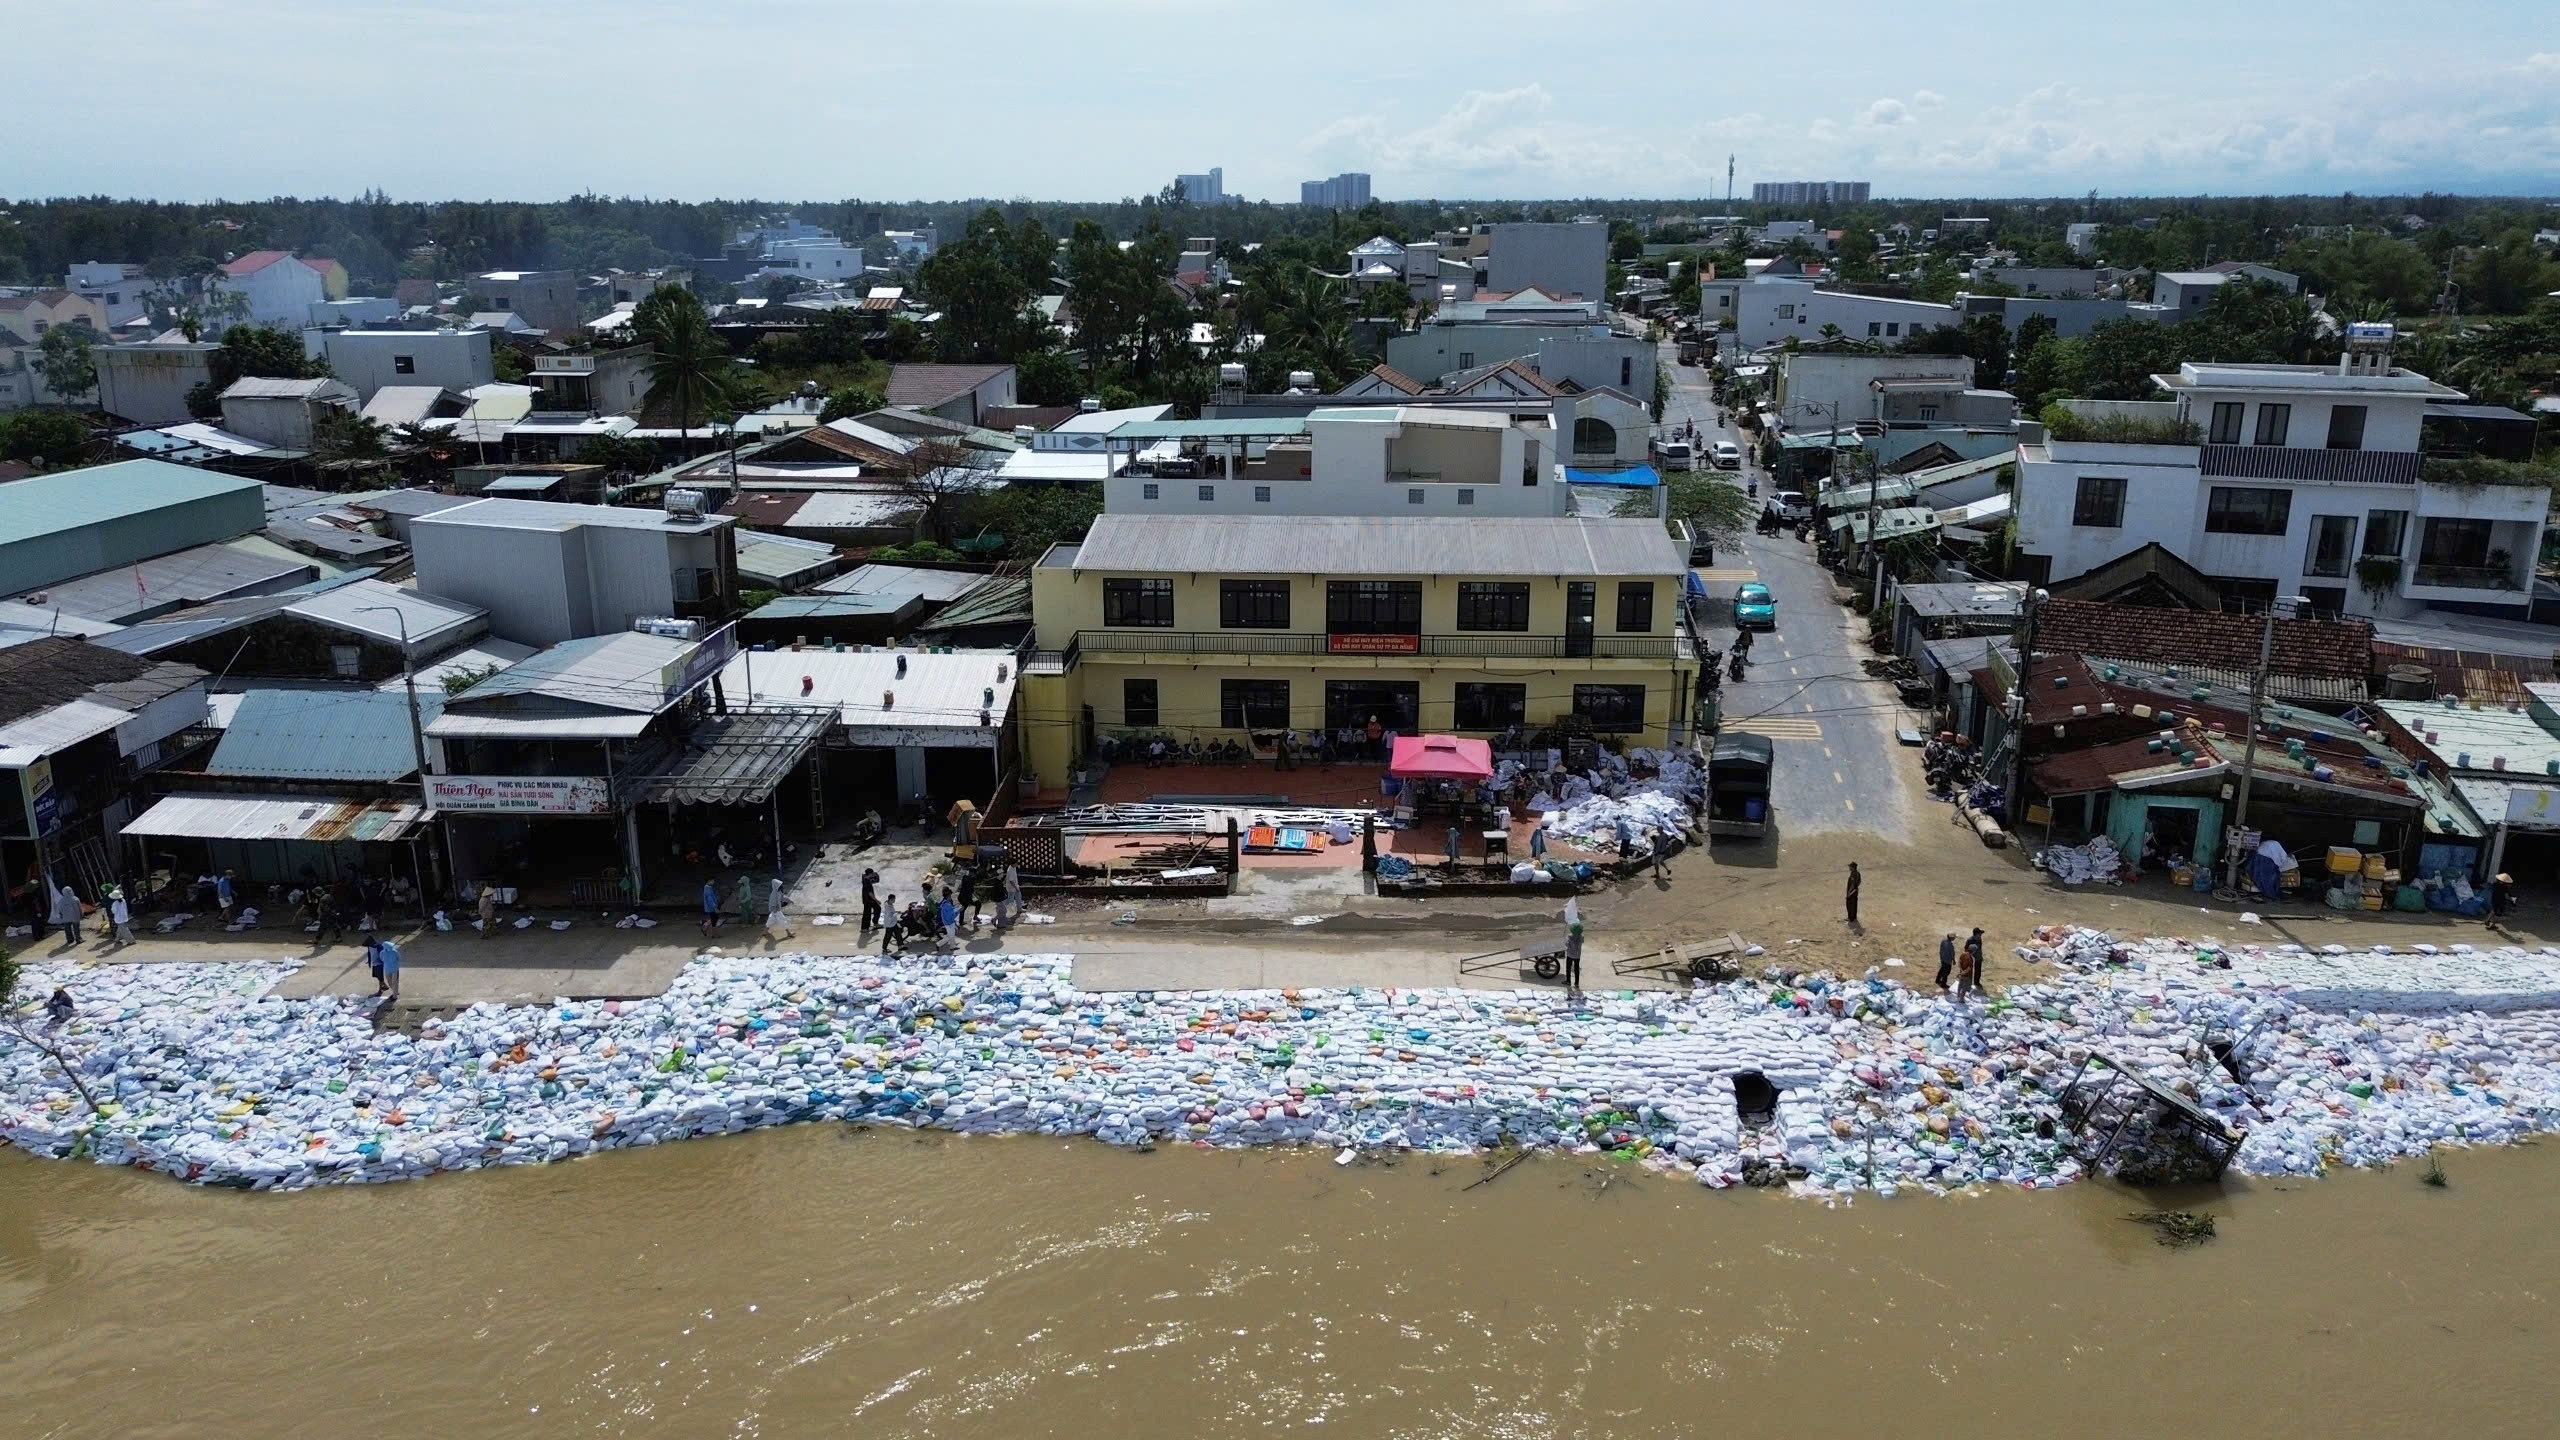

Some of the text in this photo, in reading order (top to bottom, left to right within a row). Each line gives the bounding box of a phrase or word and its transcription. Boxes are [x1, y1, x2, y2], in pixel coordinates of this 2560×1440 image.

[514, 781, 523, 789] VỤ
[523, 781, 536, 789] CÁC
[433, 783, 496, 800] Thiên Nga
[499, 799, 509, 807] GIÁ
